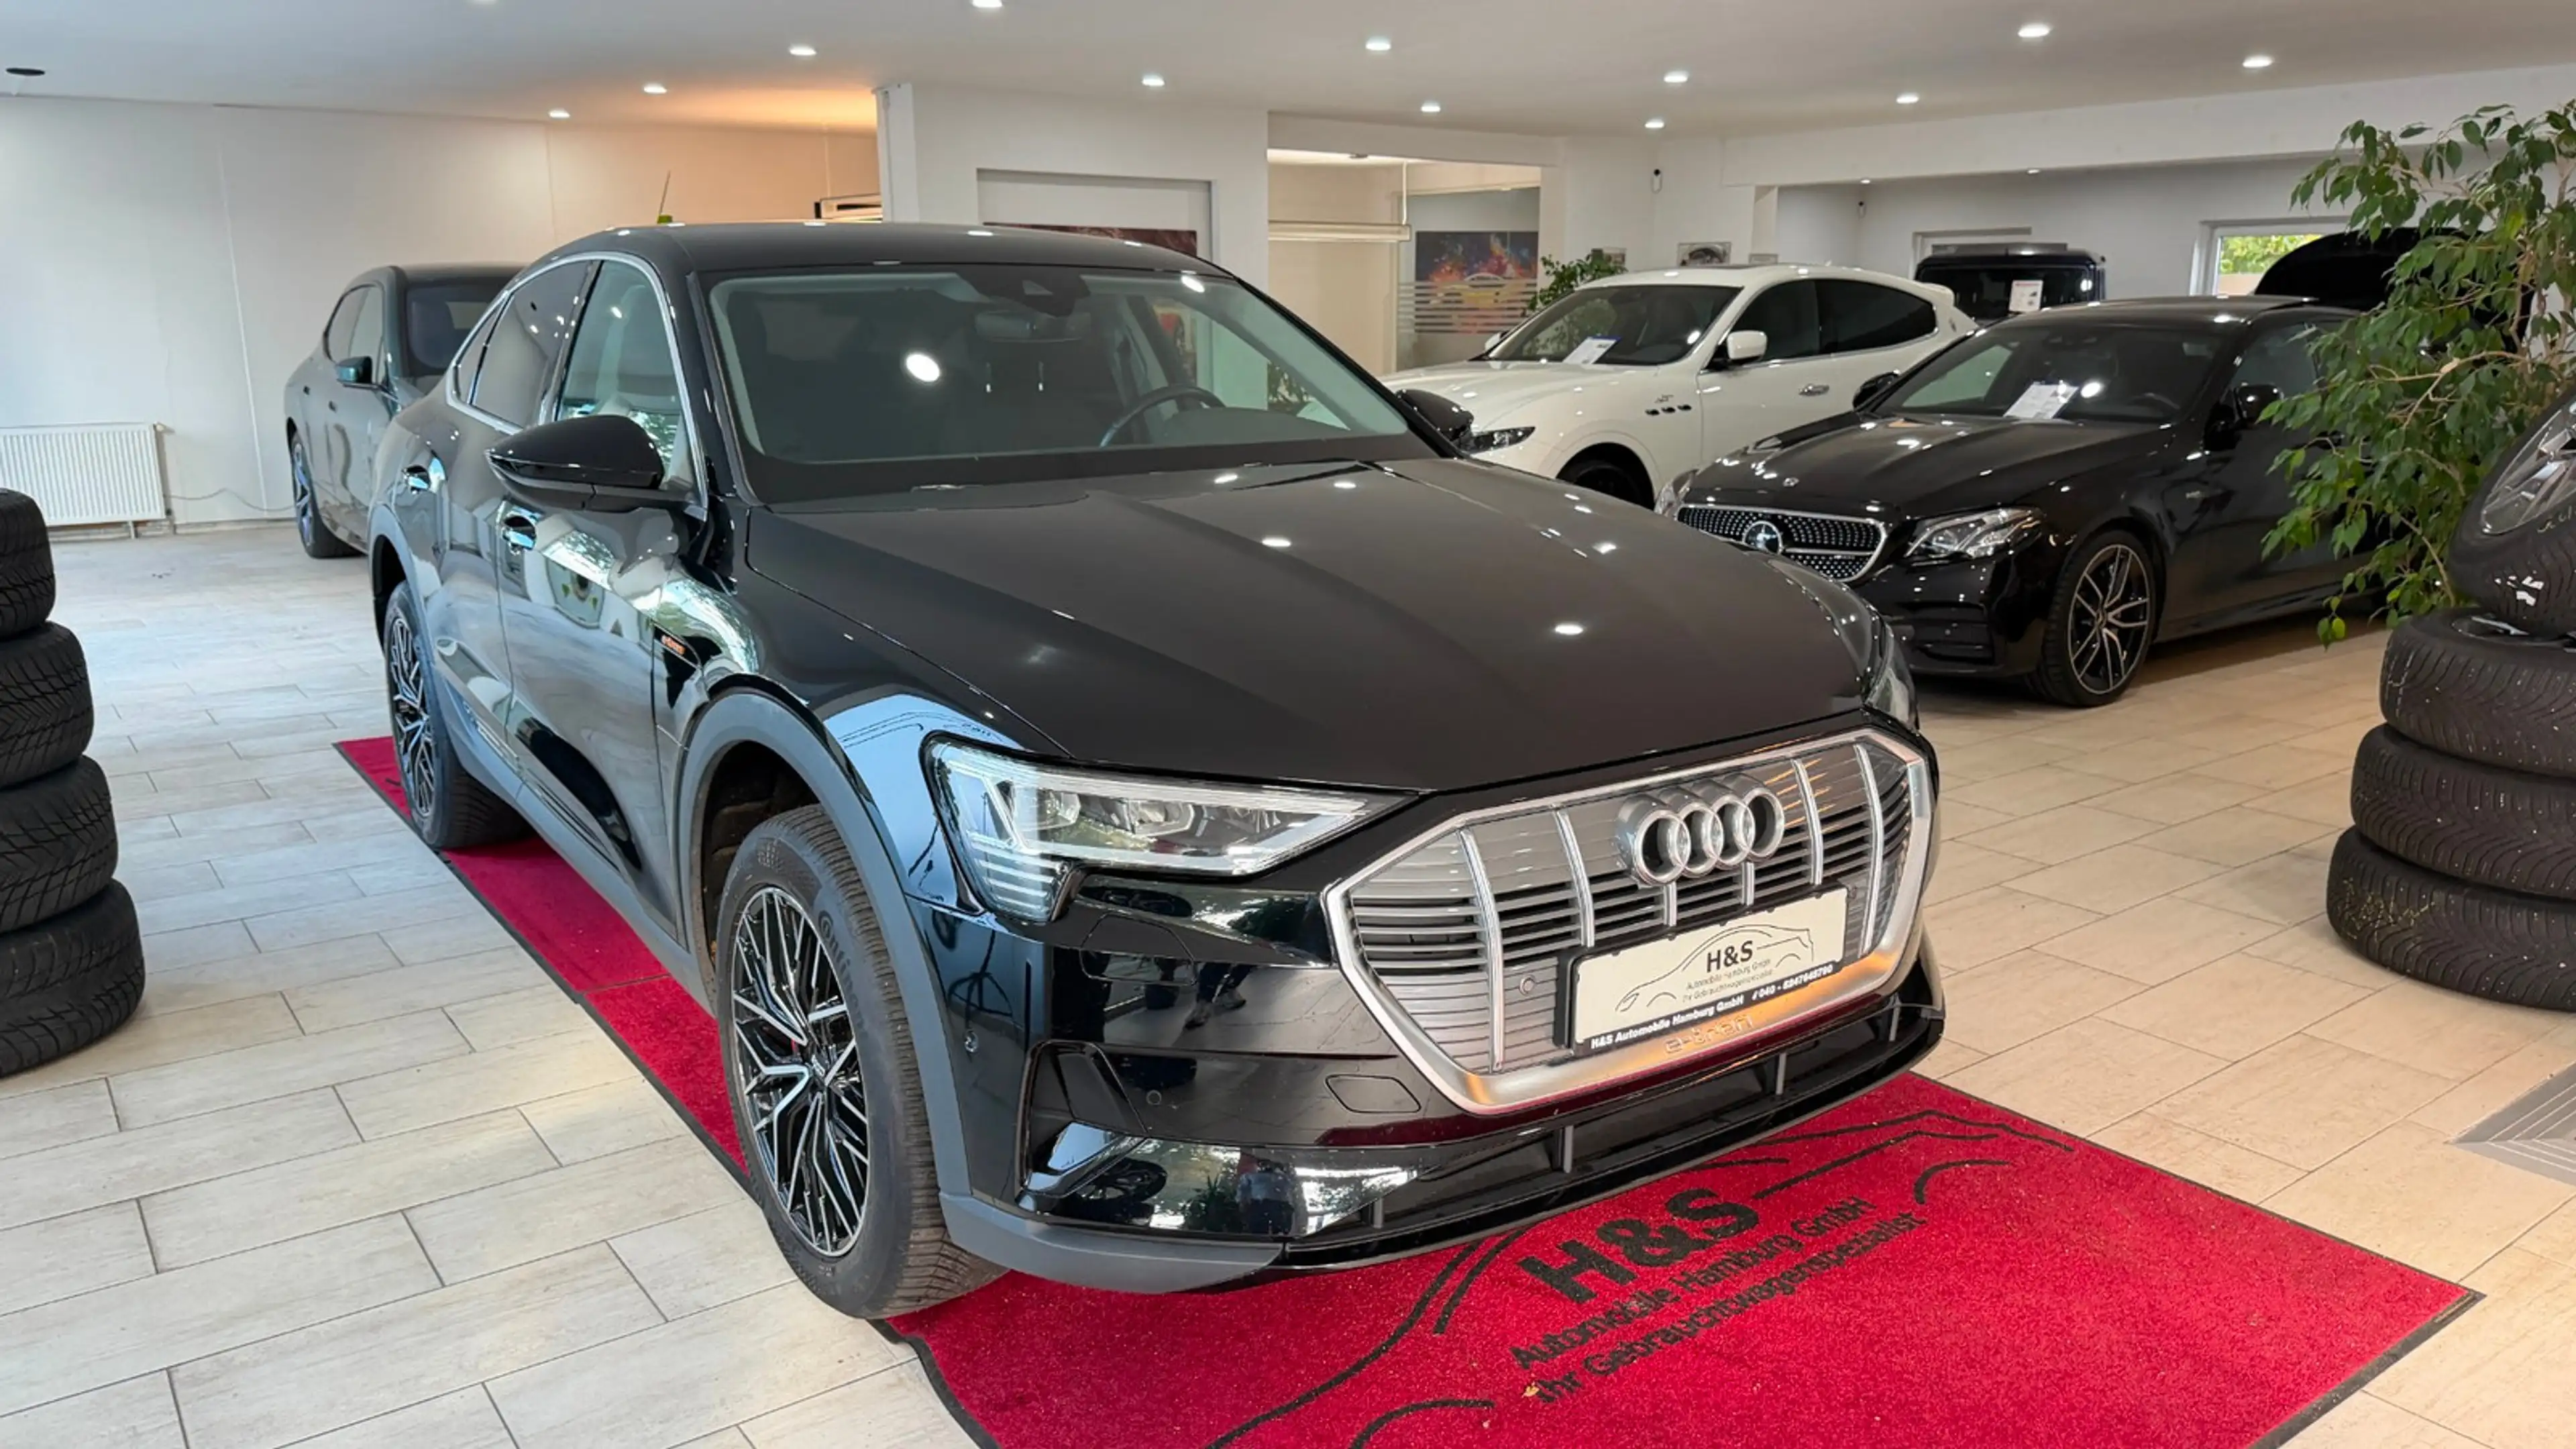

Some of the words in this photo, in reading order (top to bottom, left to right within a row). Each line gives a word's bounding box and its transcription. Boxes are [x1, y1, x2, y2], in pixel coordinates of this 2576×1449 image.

[1707, 941, 1753, 973] H&S
[1591, 1035, 1615, 1049] H&S
[1615, 1019, 1670, 1042] Automobile
[1672, 1006, 1715, 1026] Hamburg
[1717, 994, 1744, 1011] GmbH
[1510, 1288, 1681, 1369] Automobile
[1672, 1235, 1805, 1292] Hamburg
[1793, 1195, 1878, 1238] GmbH
[1518, 1188, 1759, 1303] H&S
[1535, 1369, 1583, 1403] Ihr
[1584, 1212, 1927, 1376] Gebrauchtwagenspezialist
